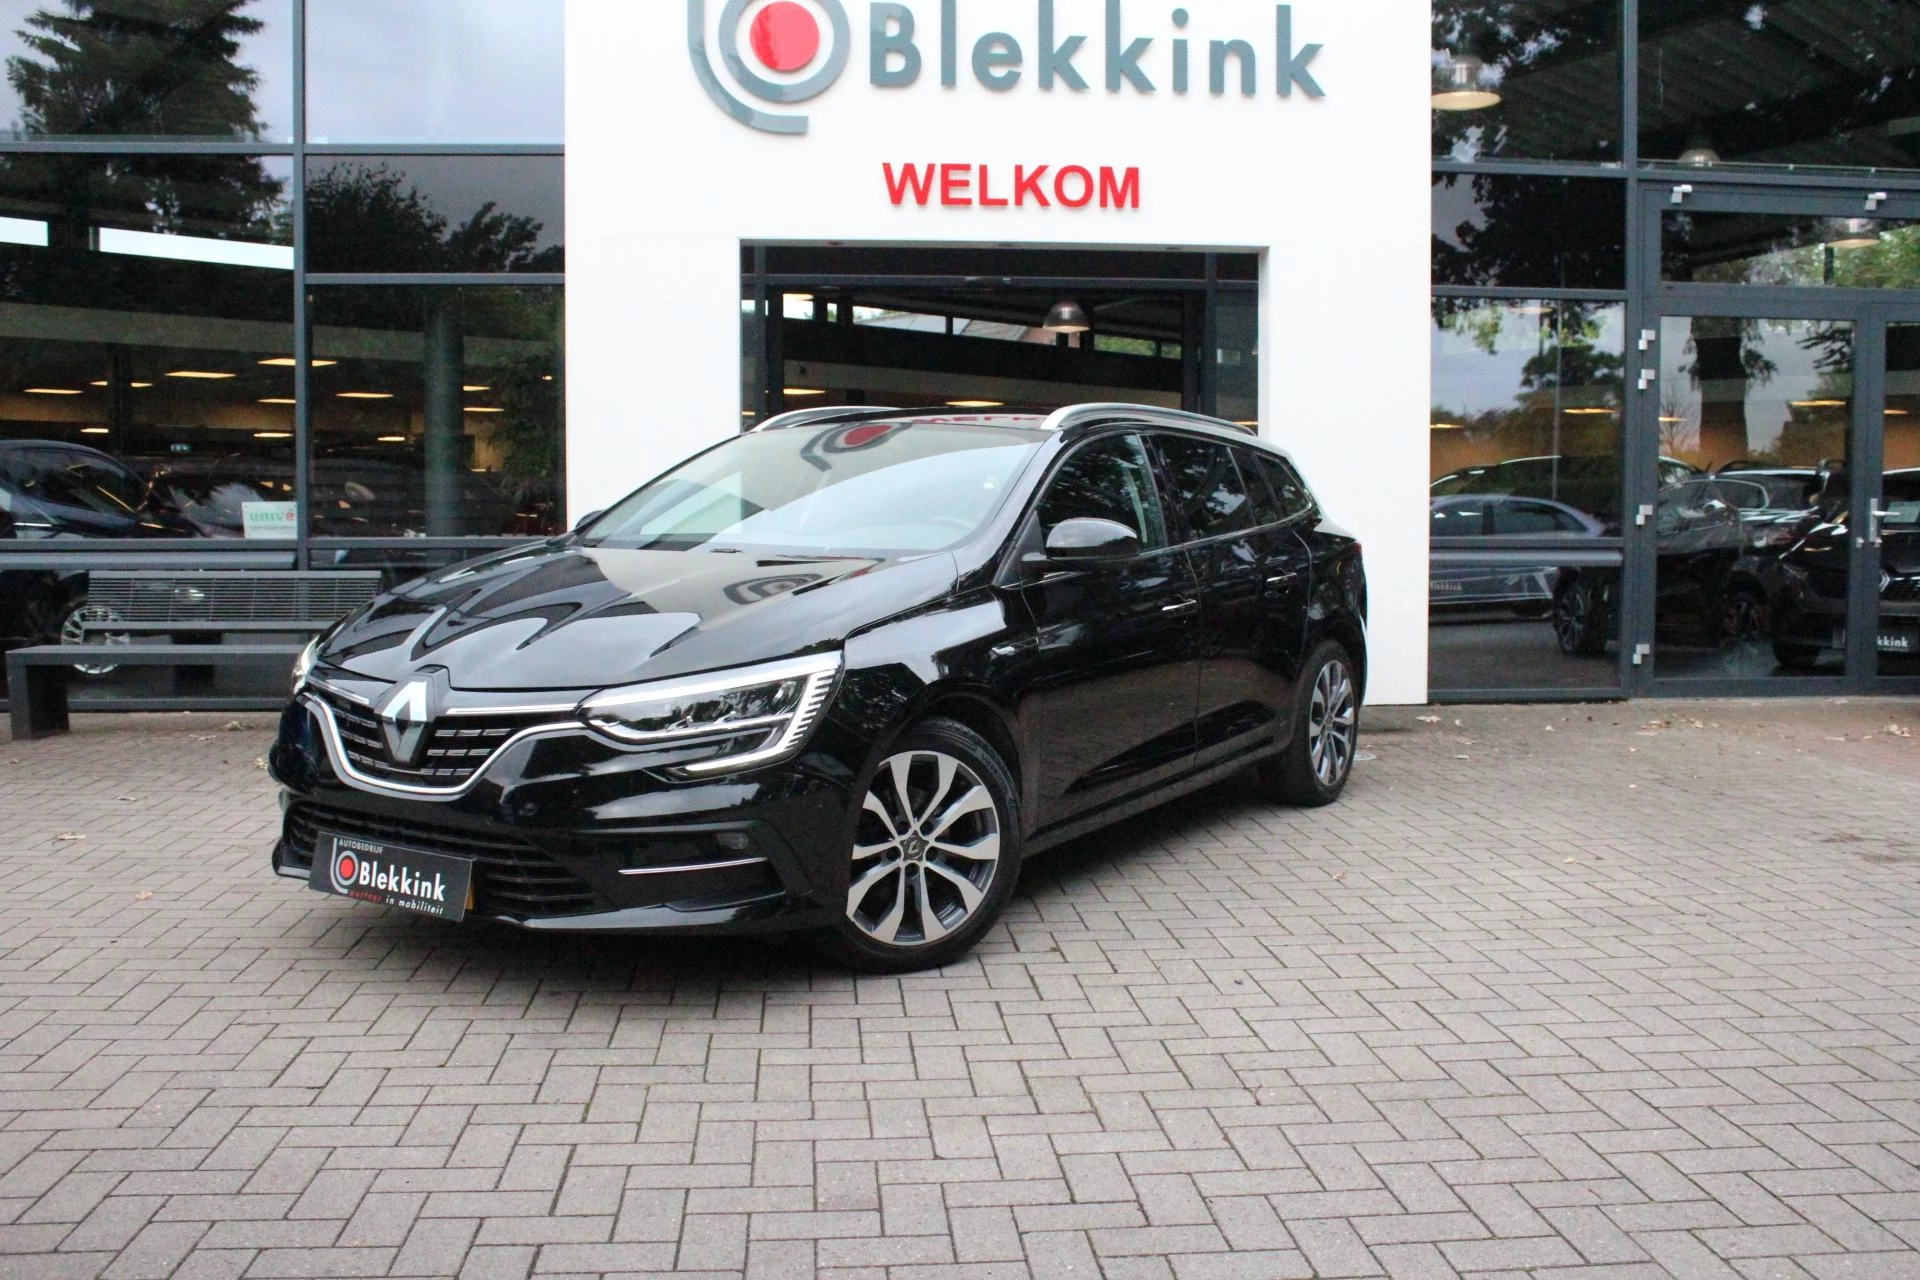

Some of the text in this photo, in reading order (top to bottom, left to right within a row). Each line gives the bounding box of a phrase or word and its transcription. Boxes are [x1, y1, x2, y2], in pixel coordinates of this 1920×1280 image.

[869, 0, 1325, 98] Blekkink
[882, 162, 1140, 210] WELKOM
[338, 838, 383, 854] AUTOBEDRIJF
[359, 861, 446, 902] Blekkink
[386, 894, 395, 905] in
[398, 899, 444, 915] mobiliteit
